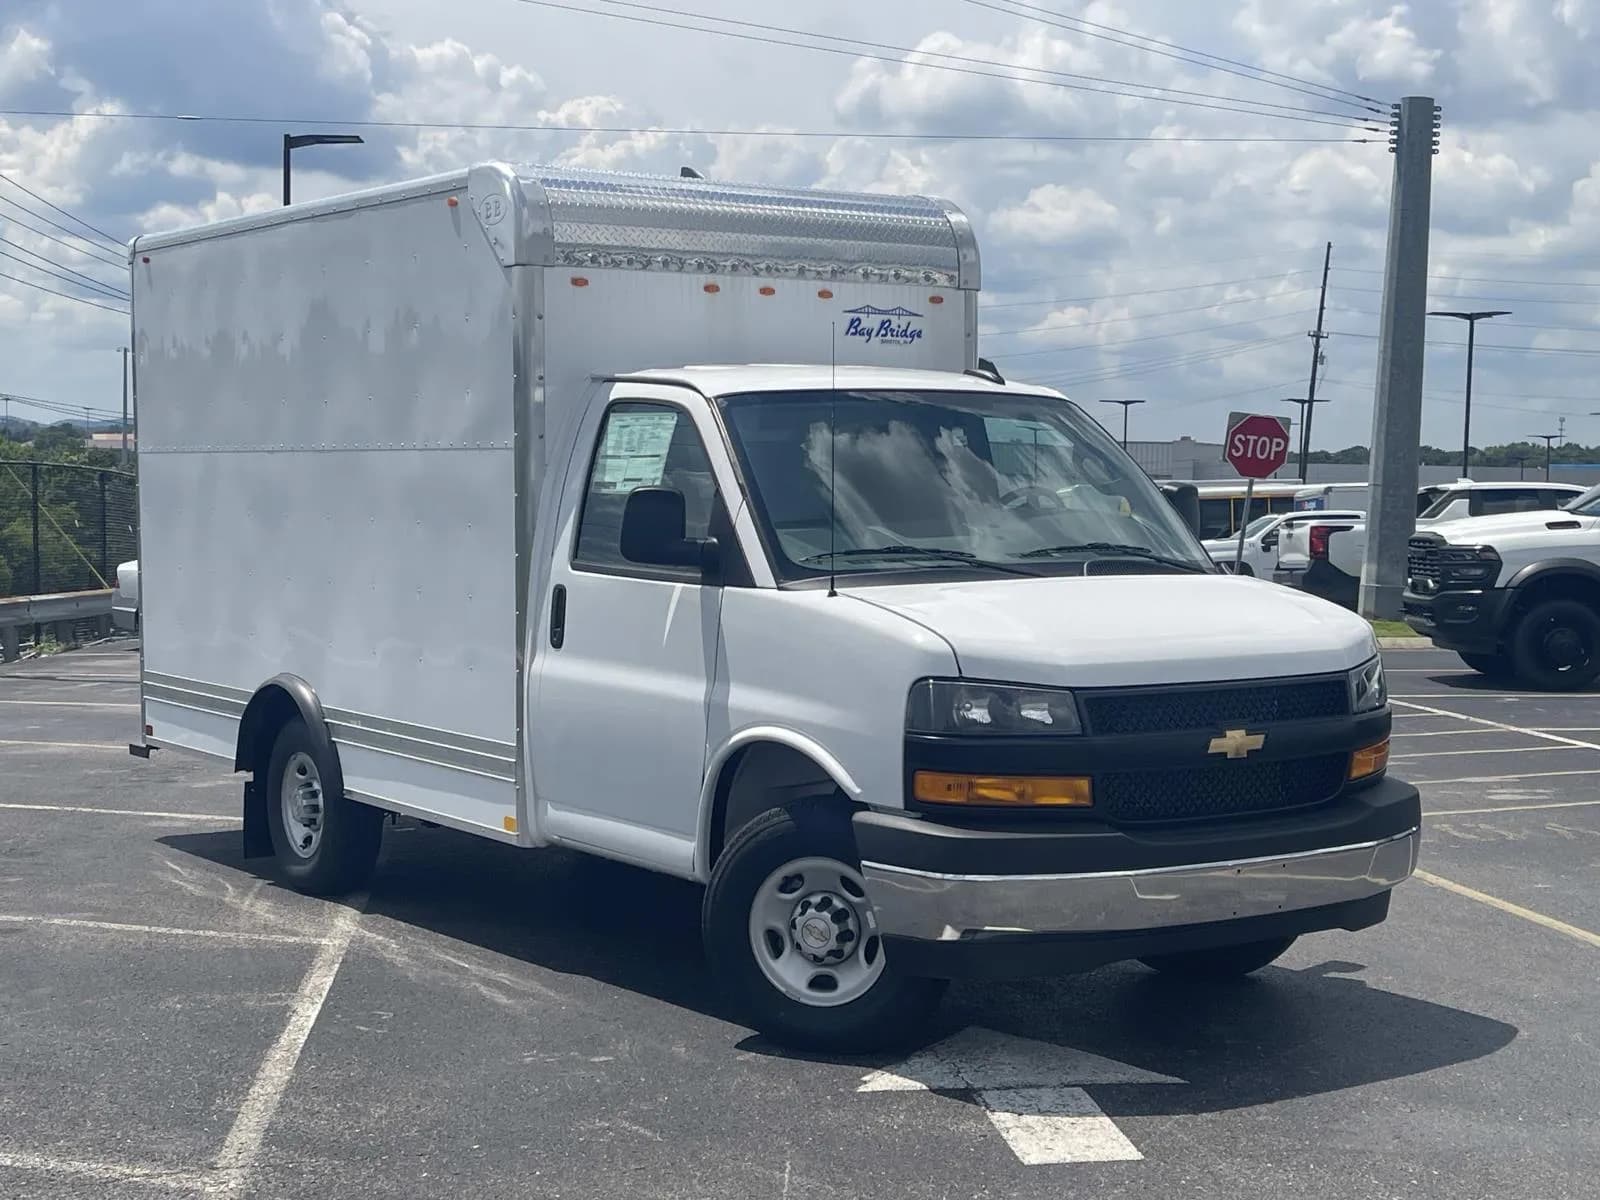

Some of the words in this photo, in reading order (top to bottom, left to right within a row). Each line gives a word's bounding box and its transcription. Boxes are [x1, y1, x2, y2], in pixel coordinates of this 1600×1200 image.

[845, 316, 874, 343] Bay
[875, 319, 922, 344] Bridge
[1231, 433, 1285, 461] STOP
